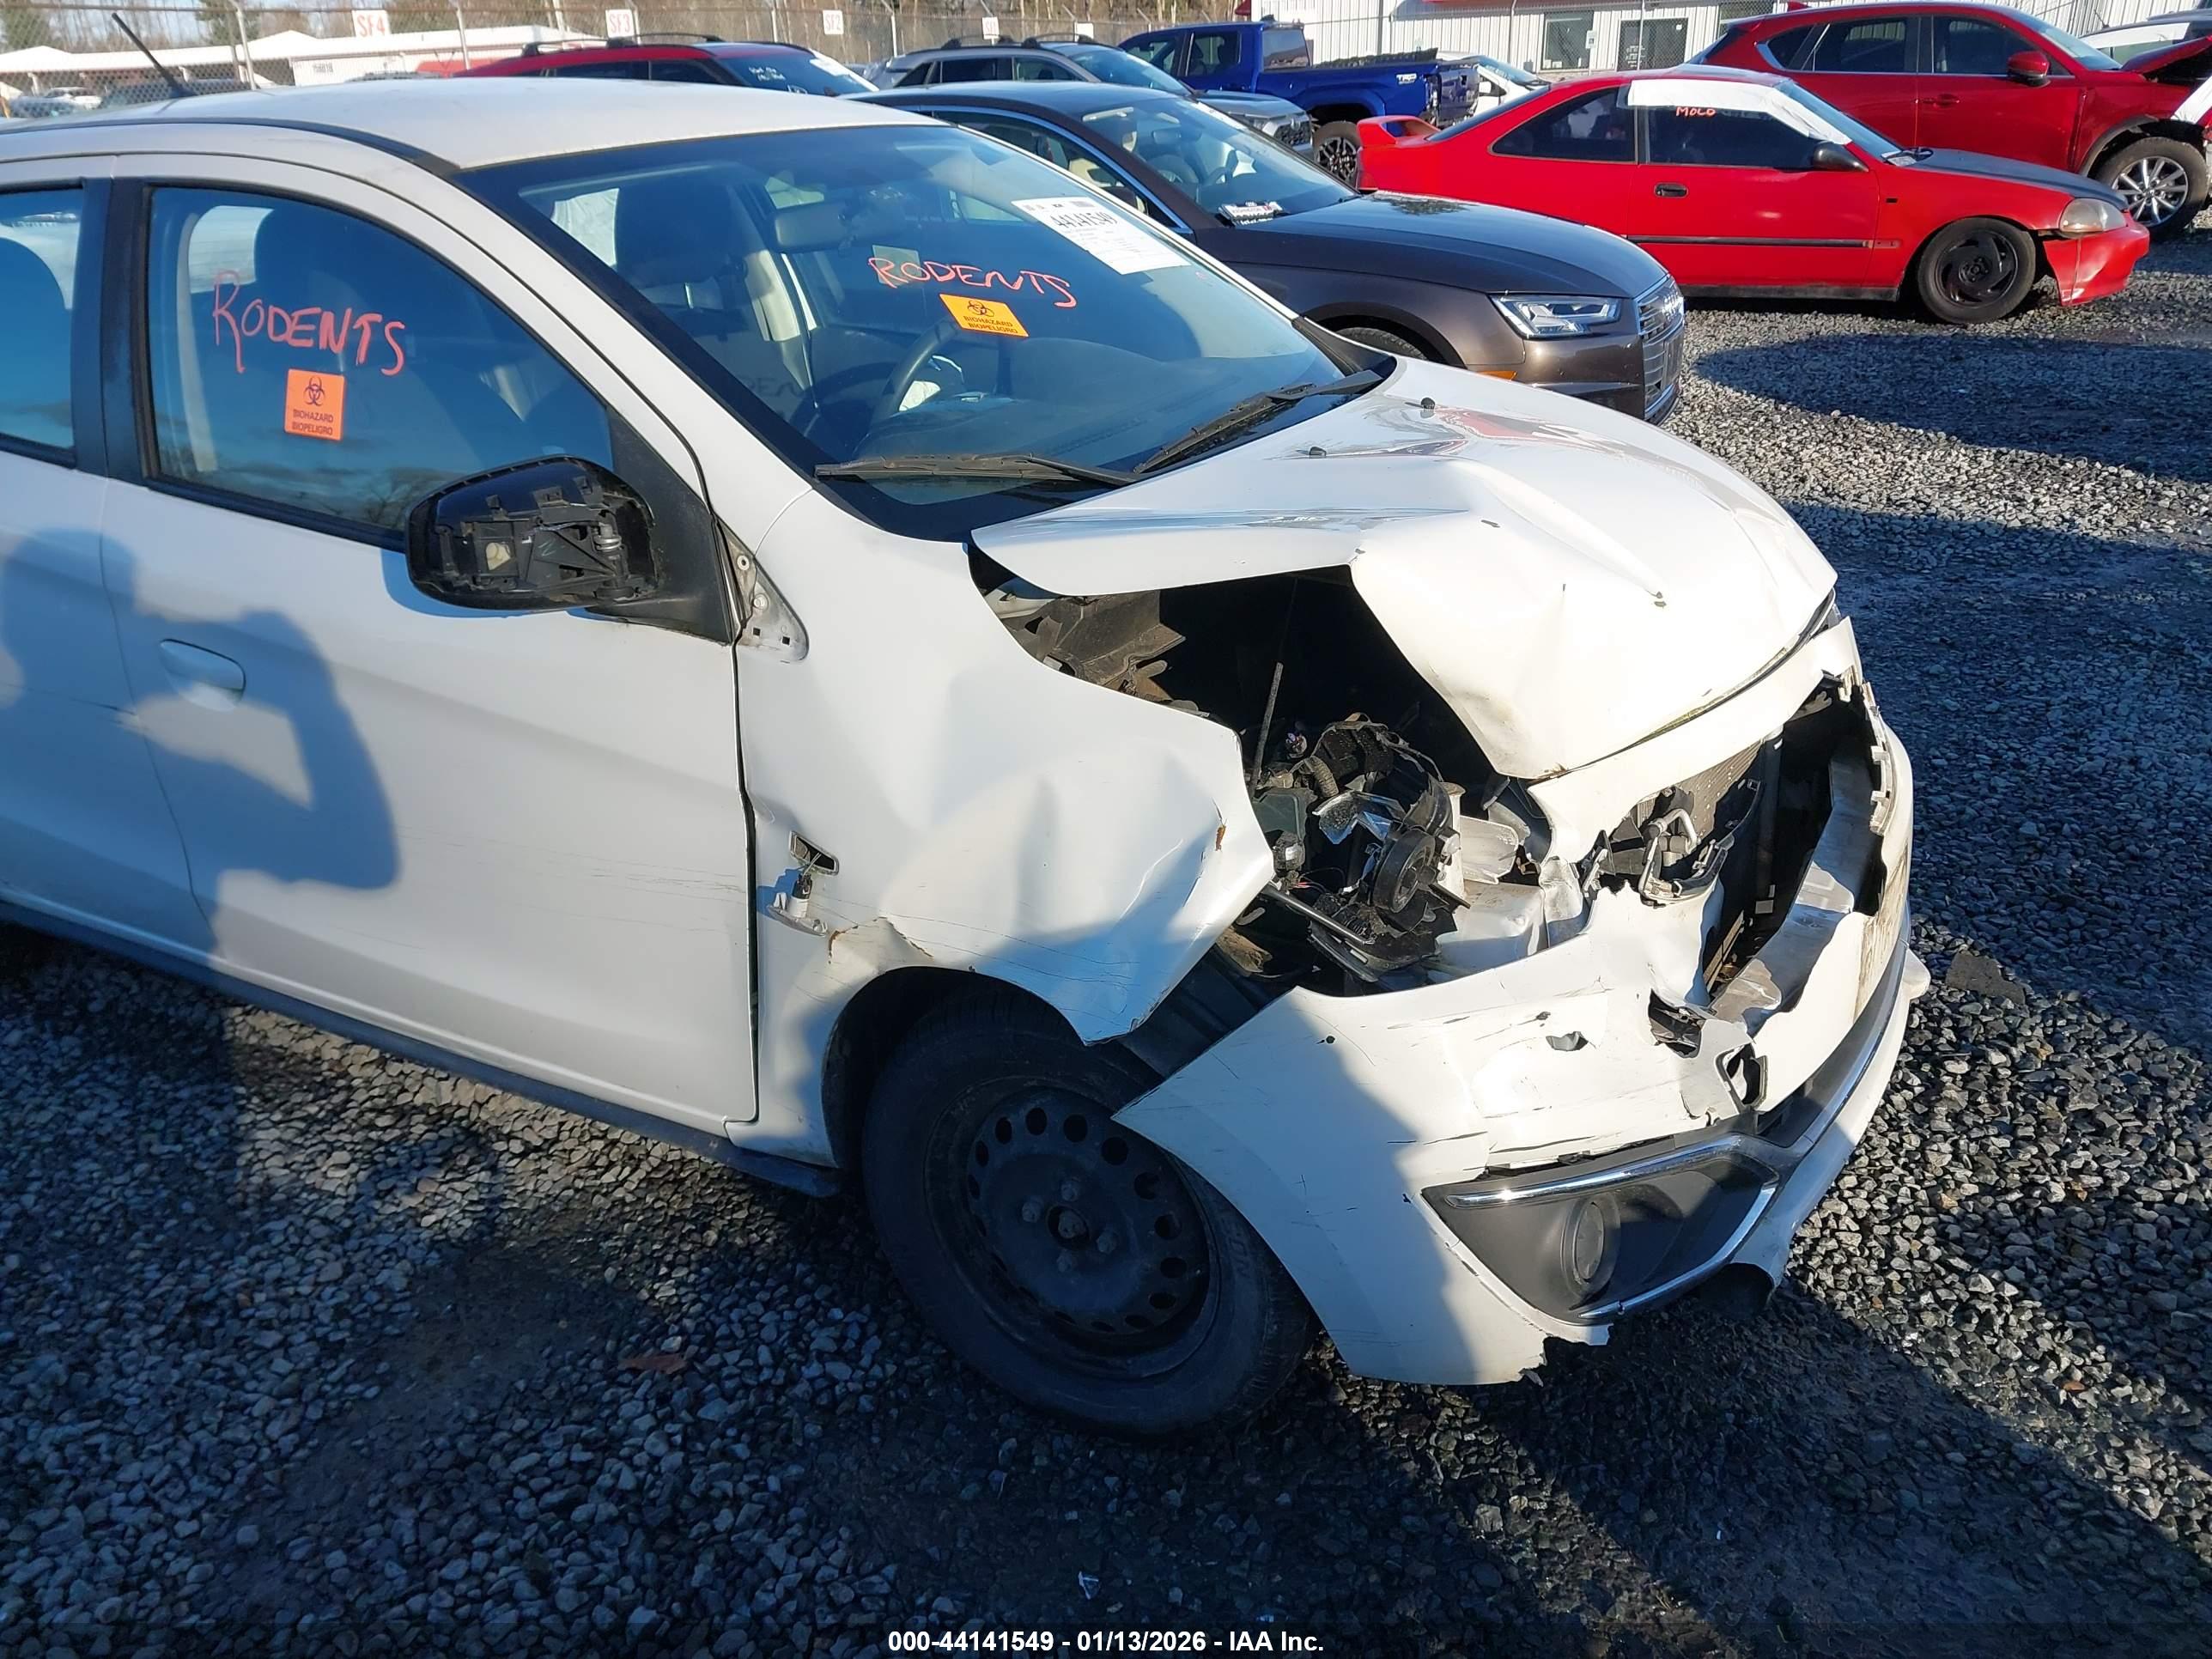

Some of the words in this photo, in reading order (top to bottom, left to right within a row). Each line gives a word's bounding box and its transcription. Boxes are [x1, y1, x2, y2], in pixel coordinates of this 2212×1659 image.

[356, 14, 386, 37] SF4
[609, 13, 630, 33] SF3
[867, 257, 1078, 308] RODENTS
[211, 268, 406, 377] RODENTS
[963, 315, 1014, 327] BIOHAZARD
[968, 322, 1019, 334] BIOPELIGRO
[292, 408, 334, 423] BIOHAZARD
[291, 421, 334, 435] BIOPELIGRO
